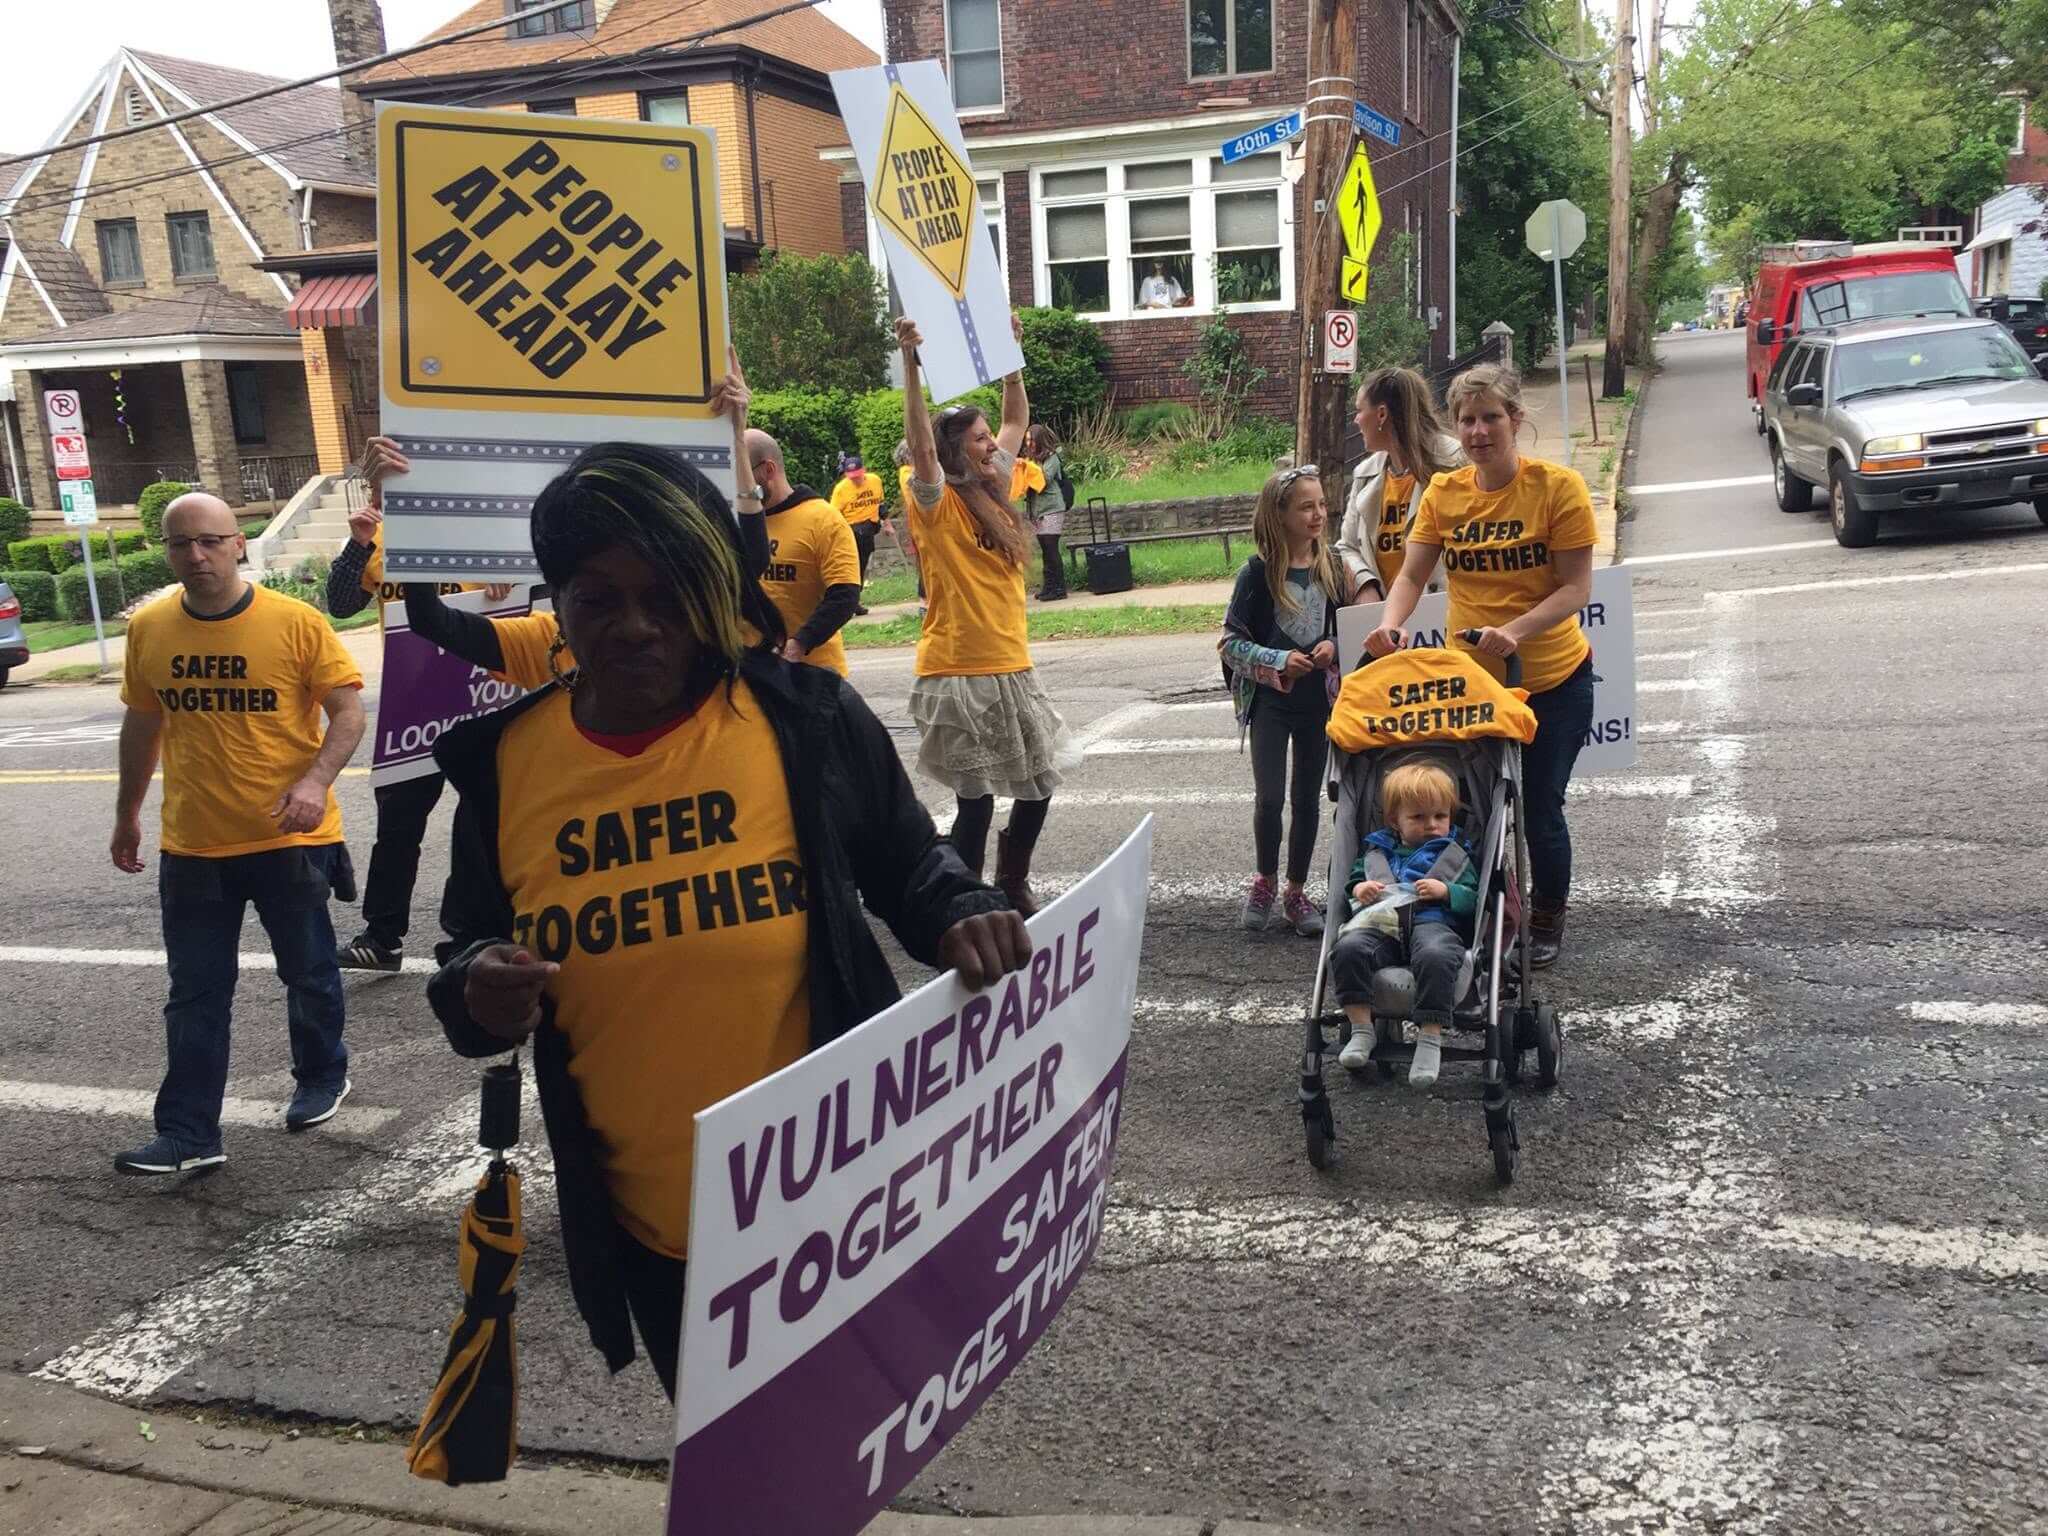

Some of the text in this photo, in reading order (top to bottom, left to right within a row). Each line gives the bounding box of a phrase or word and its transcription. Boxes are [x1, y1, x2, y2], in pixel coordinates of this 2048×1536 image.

[1234, 120, 1293, 155] 40th St
[1355, 109, 1395, 141] avison St
[891, 145, 947, 183] PEOPLE
[897, 176, 960, 221] AT PLAY
[502, 139, 692, 308] PEOPLE
[915, 211, 963, 249] AHEAD
[432, 165, 666, 360] AT PLAY
[411, 227, 587, 379] AHEAD
[1452, 520, 1524, 543] SAFER
[170, 654, 248, 679] SAFER
[1388, 676, 1466, 708] SAFER
[1363, 702, 1495, 736] TOGETHER
[555, 790, 738, 878] SAFER
[727, 907, 1100, 1231] VULNERABLE
[995, 1087, 1118, 1273] SAFER
[709, 1042, 1063, 1370] TOGETHER
[857, 1178, 1105, 1497] TOGETHER
